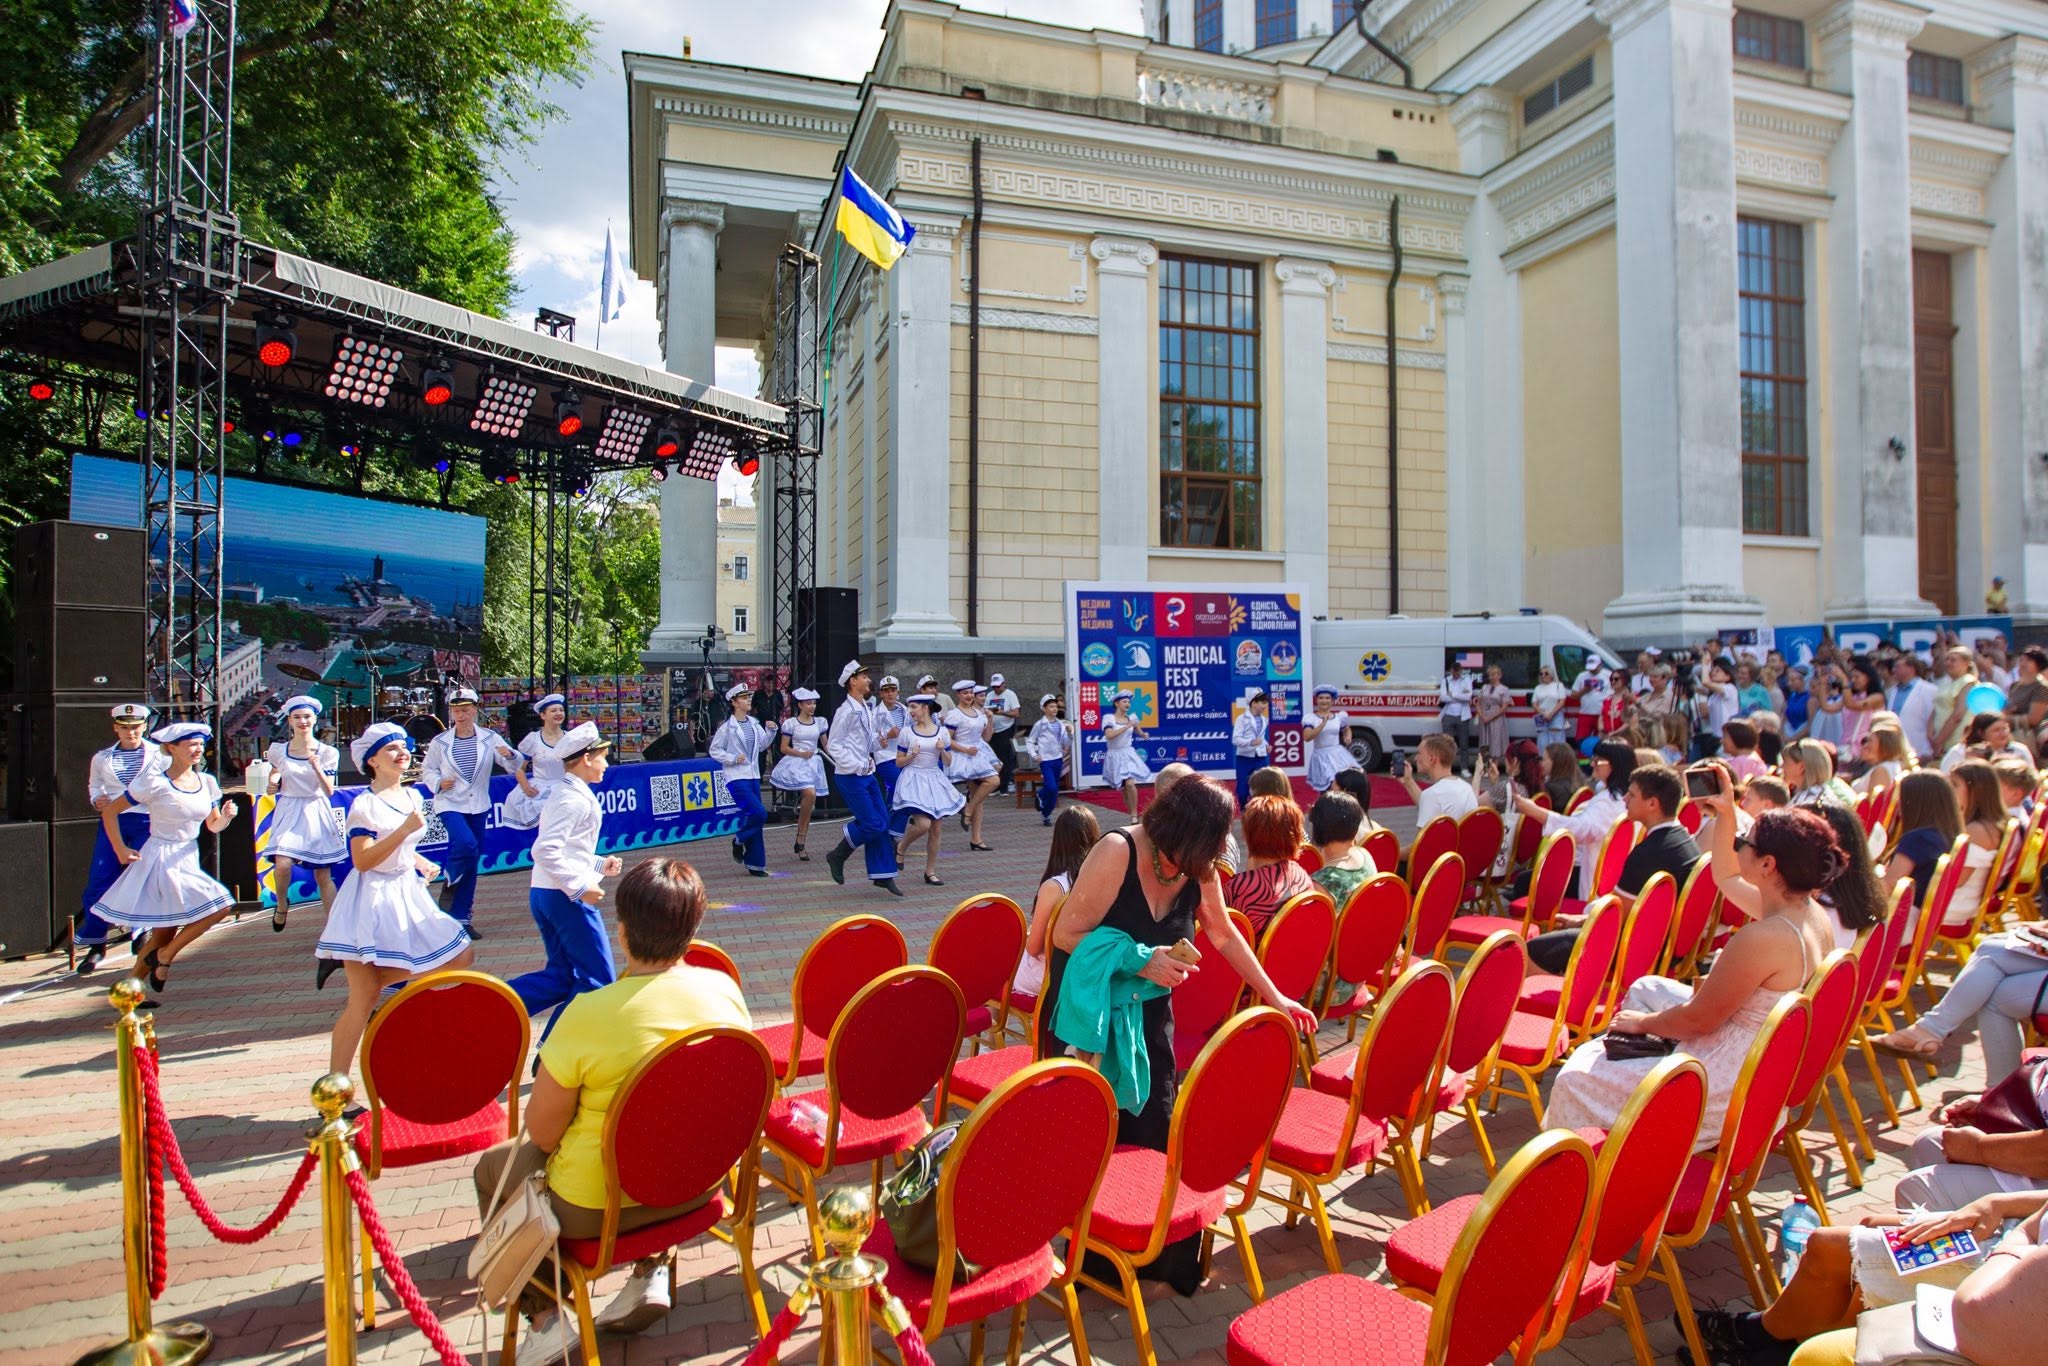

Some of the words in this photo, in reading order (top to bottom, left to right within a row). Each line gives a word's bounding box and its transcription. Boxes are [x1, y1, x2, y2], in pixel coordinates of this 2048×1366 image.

[1164, 645, 1227, 665] MEDICAL
[1165, 667, 1199, 687] FEST
[1166, 690, 1203, 709] 2026
[1334, 696, 1385, 706] КСТРЕНА
[1204, 711, 1228, 720] ОДЕСА
[1274, 730, 1301, 747] 20
[1274, 746, 1300, 763] 26
[598, 788, 637, 816] 2026
